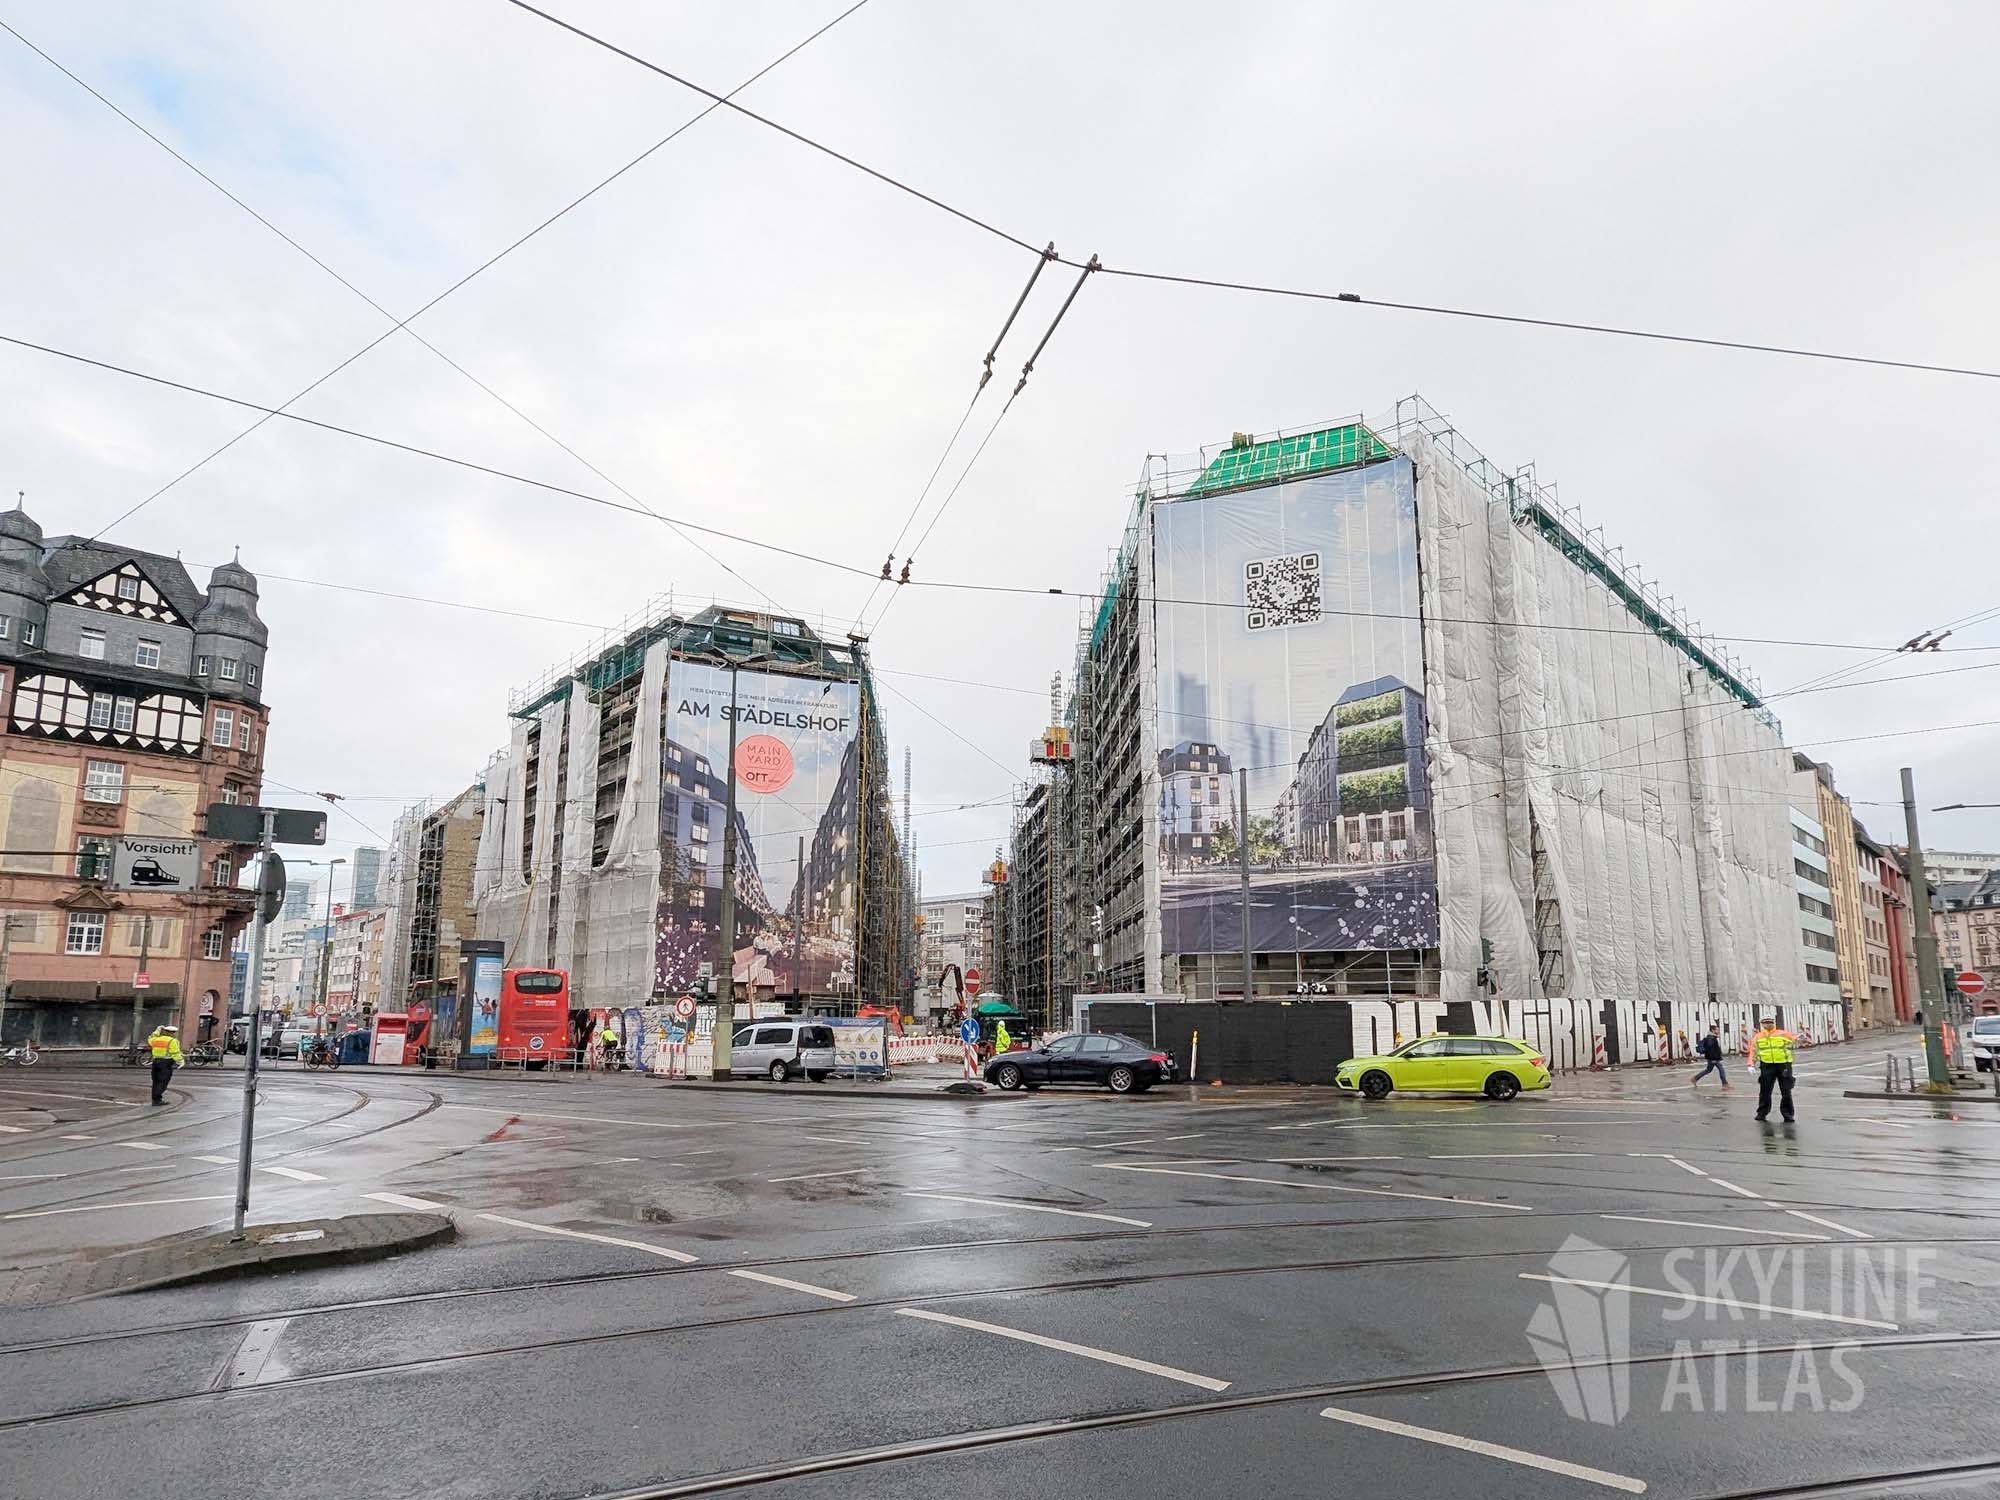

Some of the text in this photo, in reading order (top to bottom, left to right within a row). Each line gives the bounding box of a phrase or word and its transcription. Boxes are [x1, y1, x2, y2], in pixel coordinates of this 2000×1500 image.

[676, 699, 850, 732] AM STÄDELSHOF
[747, 744, 782, 756] MAIN
[747, 754, 782, 766] YARD
[124, 841, 194, 856] Vorsicht!
[1615, 998, 1663, 1065] DES
